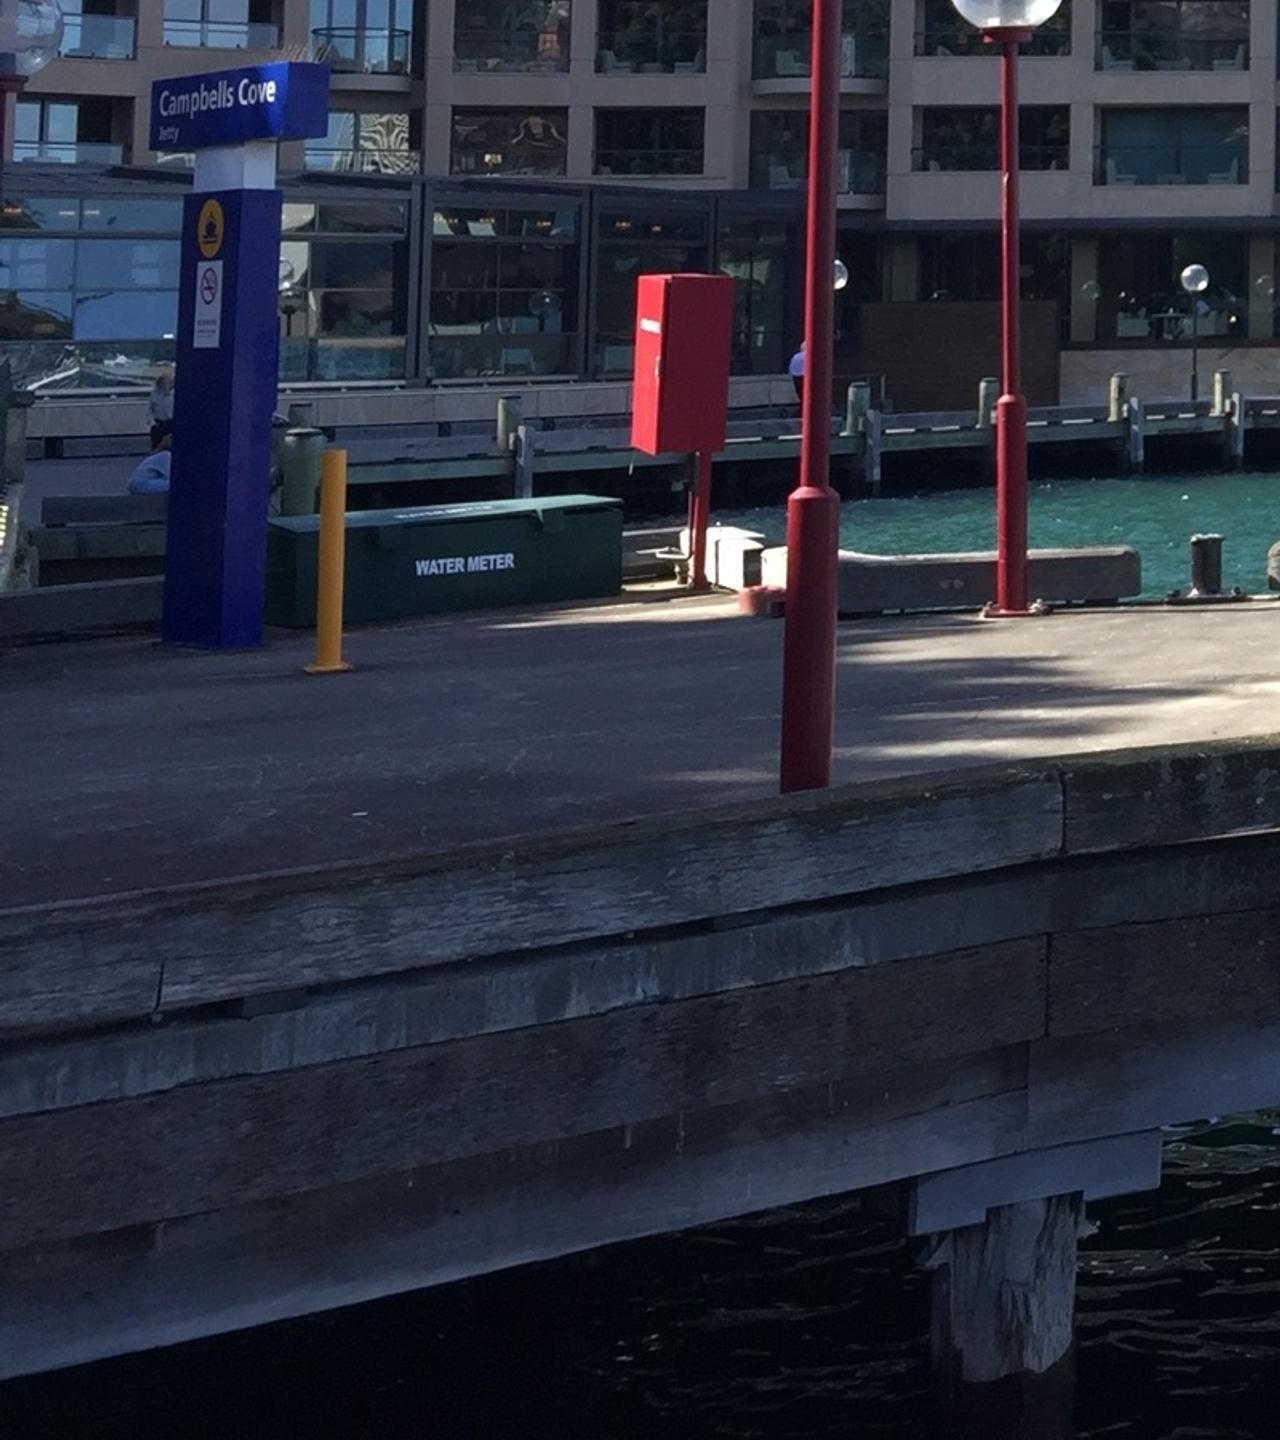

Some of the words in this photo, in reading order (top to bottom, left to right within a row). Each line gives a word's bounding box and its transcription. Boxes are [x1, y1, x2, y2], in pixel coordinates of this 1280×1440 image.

[159, 80, 234, 119] Campbells
[238, 77, 277, 106] Cove
[158, 125, 180, 144] Jetty
[415, 557, 465, 576] WATER
[467, 553, 515, 572] METER
